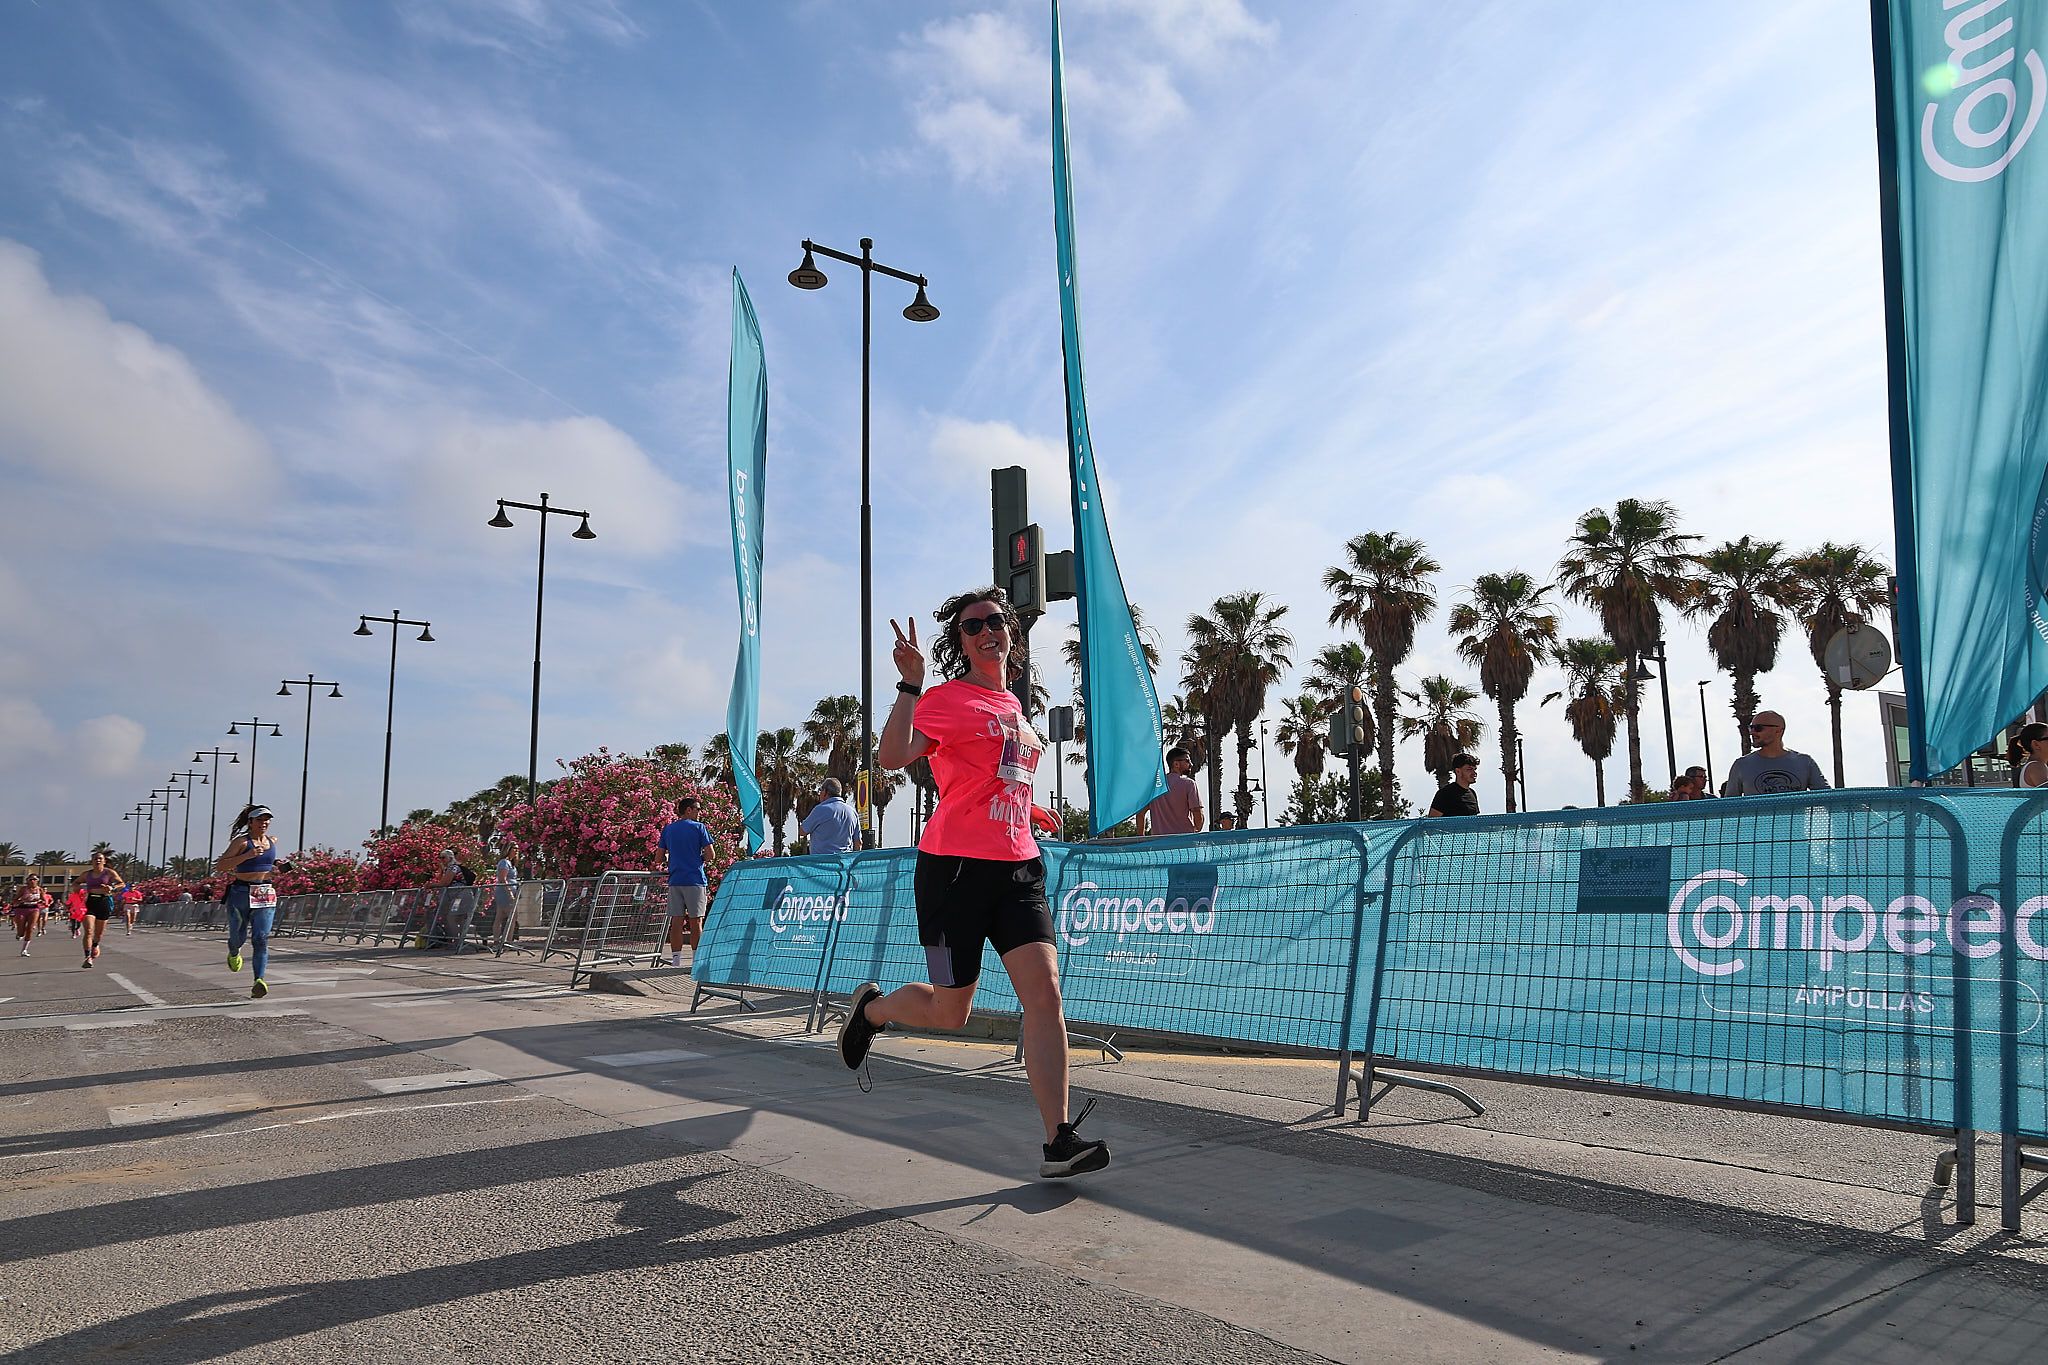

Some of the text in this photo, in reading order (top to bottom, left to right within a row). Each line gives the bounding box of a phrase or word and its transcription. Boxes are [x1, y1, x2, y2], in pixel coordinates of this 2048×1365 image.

[1921, 0, 2047, 182] Com
[770, 885, 852, 933] Compeed
[1060, 881, 1219, 946] Compeed
[1104, 950, 1157, 965] AMPOLLAS
[1794, 984, 1936, 1013] AMPOLLAS
